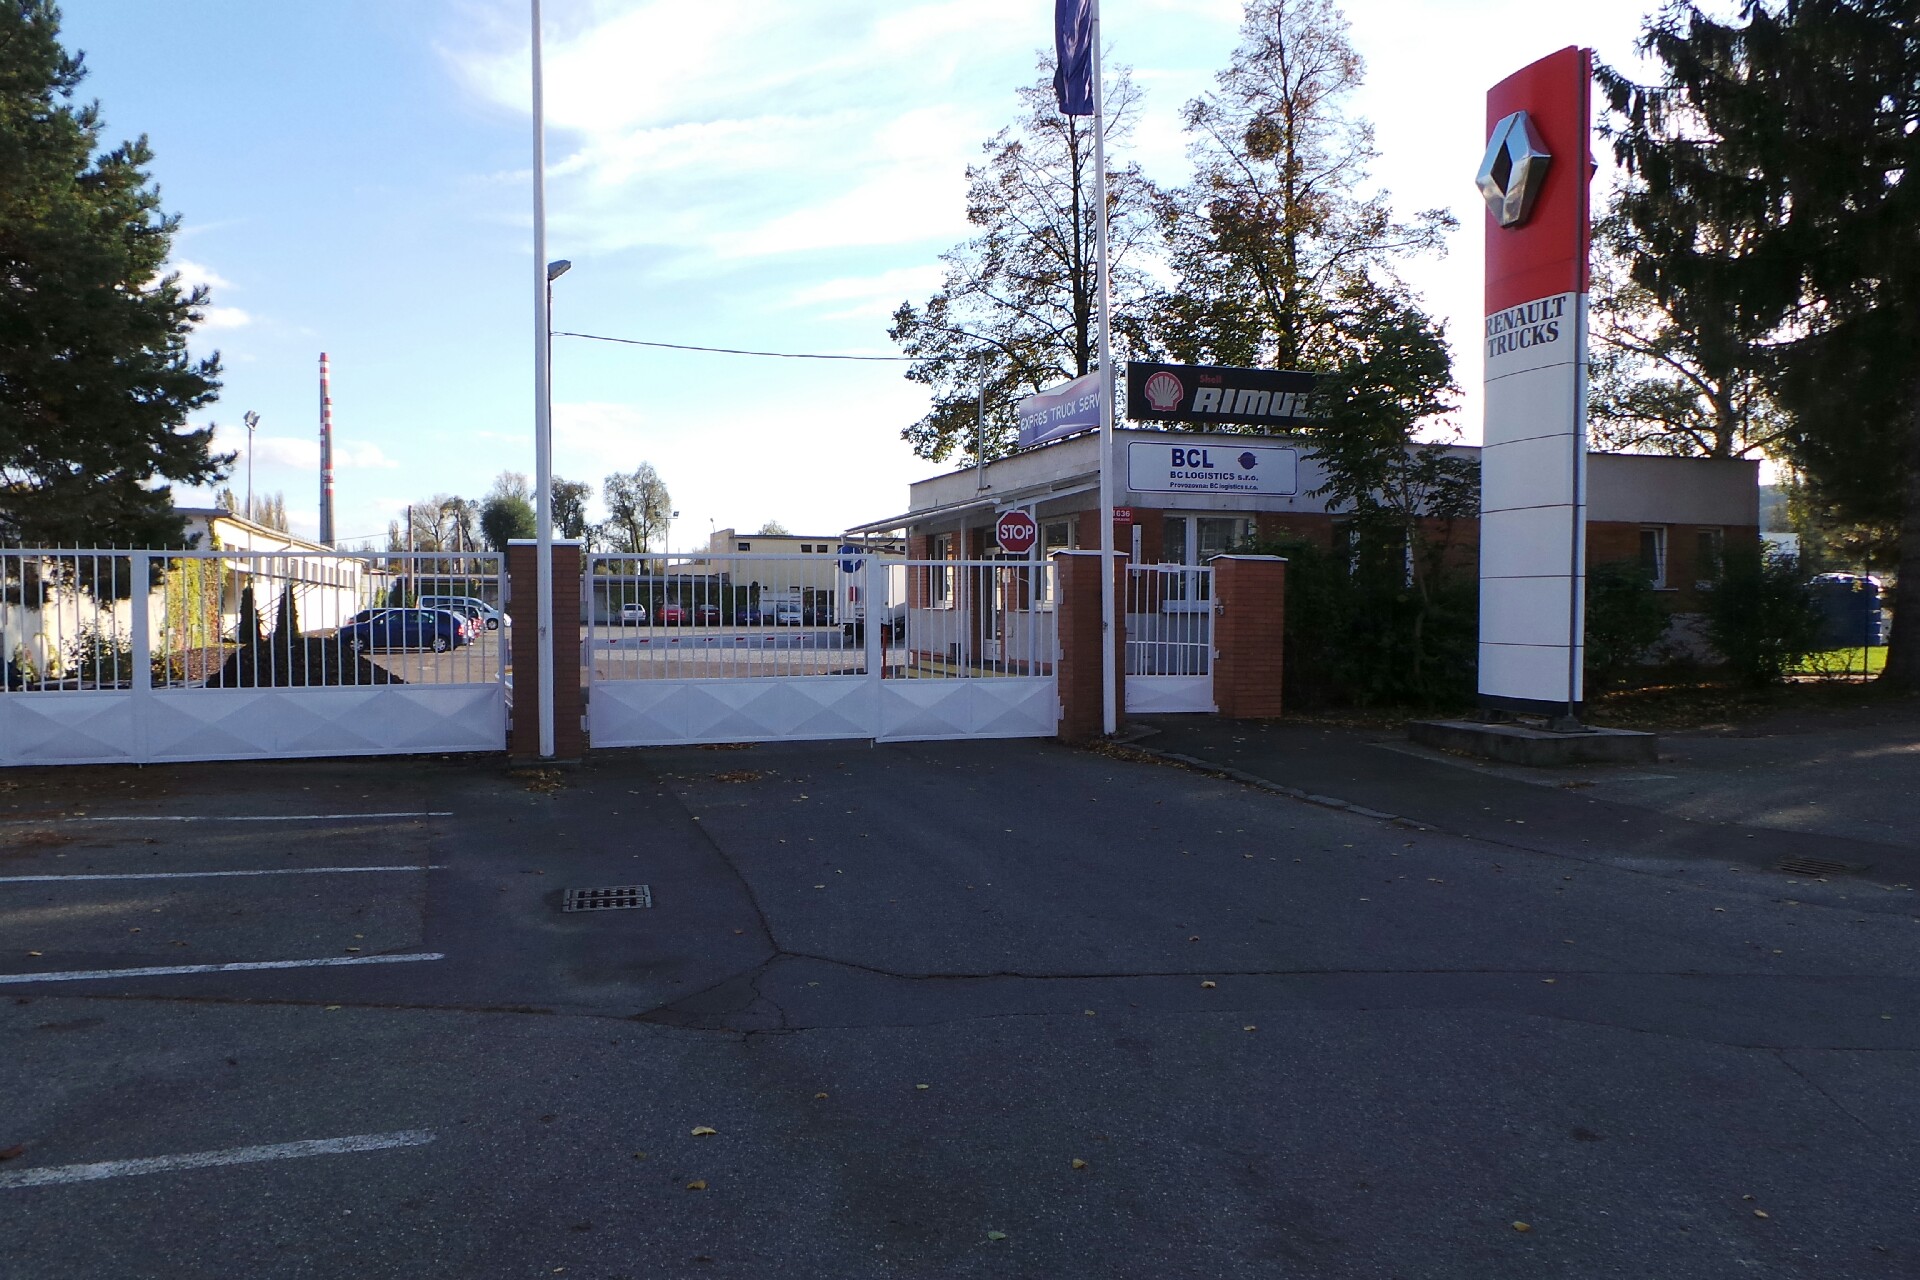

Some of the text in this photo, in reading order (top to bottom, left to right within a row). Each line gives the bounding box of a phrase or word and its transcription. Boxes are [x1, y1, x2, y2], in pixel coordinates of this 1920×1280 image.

[1485, 295, 1566, 338] RENAULT
[1488, 320, 1559, 358] TRUCKS
[1199, 374, 1222, 384] Shell
[1020, 391, 1101, 431] EXPRES TRUCK SERV
[1171, 448, 1214, 468] BCL
[1170, 471, 1184, 479] BC
[1185, 472, 1235, 480] LOGISTICS
[1000, 525, 1034, 540] STOP
